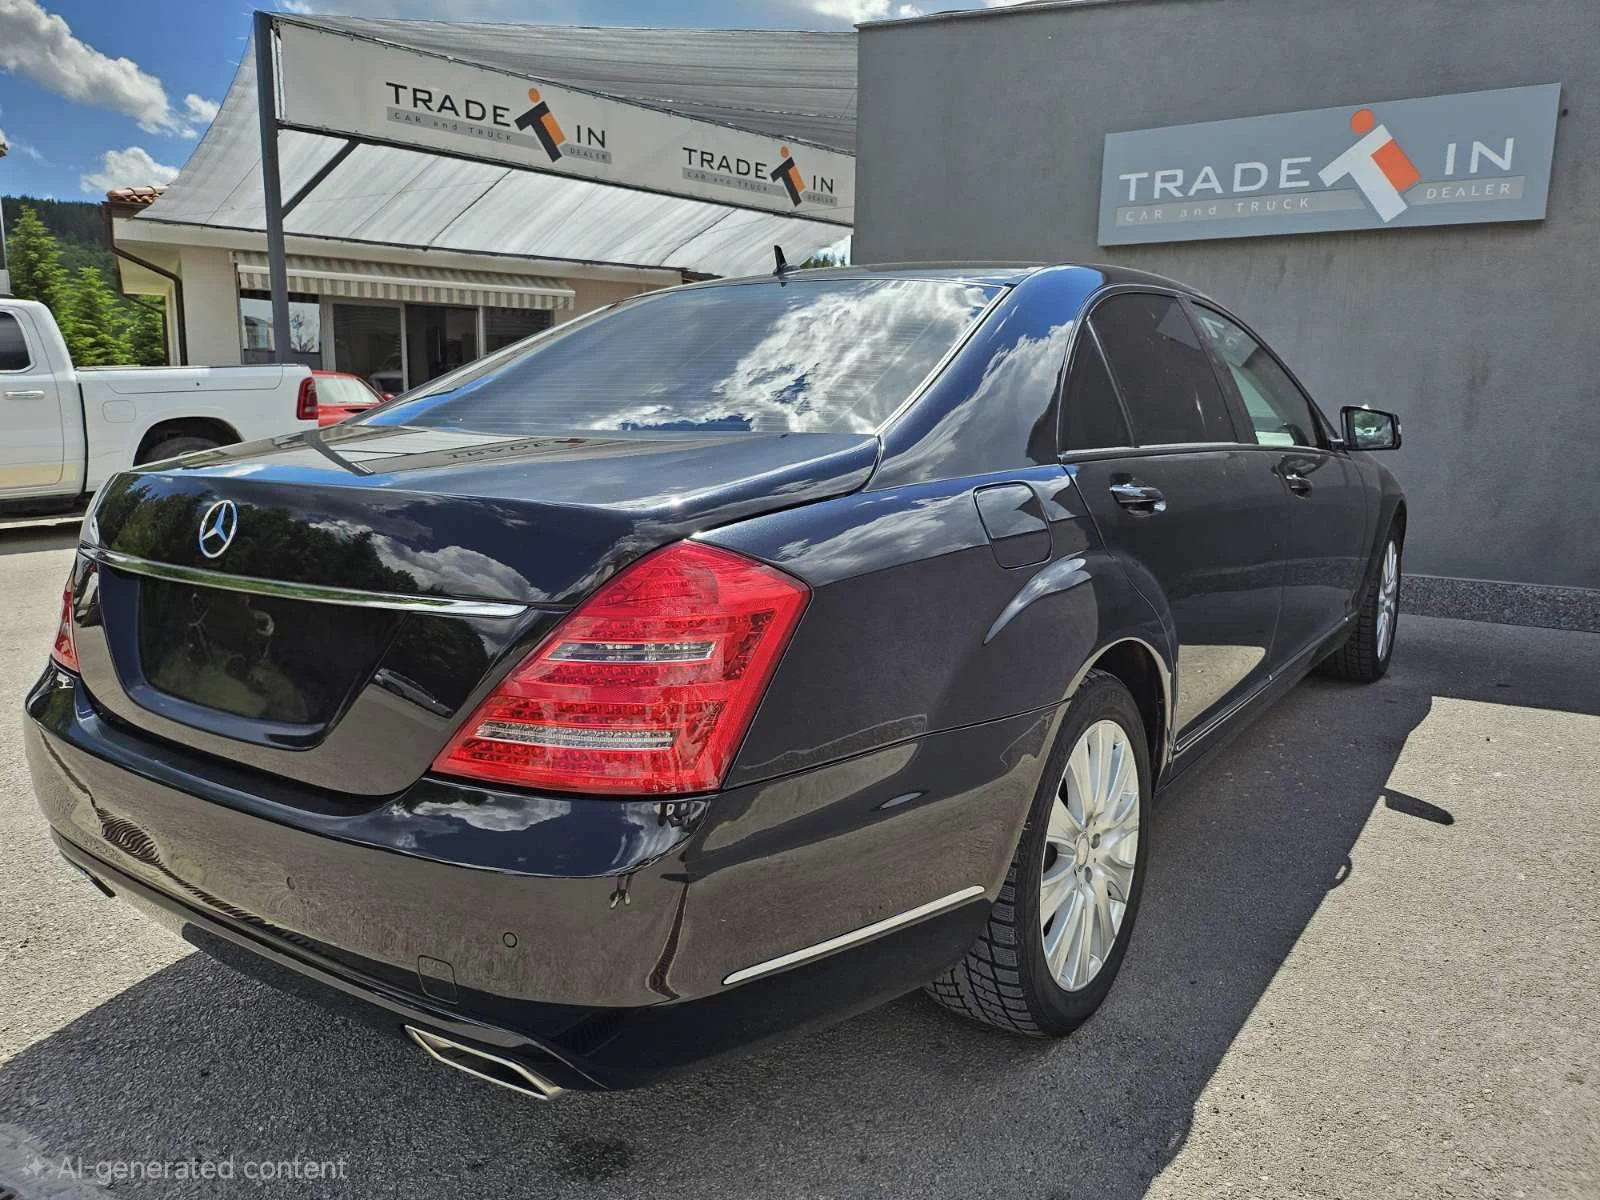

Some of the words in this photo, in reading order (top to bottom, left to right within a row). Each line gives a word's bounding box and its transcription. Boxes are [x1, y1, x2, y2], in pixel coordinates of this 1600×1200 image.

[386, 82, 511, 127] TRADE
[577, 125, 605, 148] IN
[394, 112, 421, 123] CAR
[683, 147, 767, 180] TRADE
[813, 175, 834, 194] IN
[1119, 157, 1312, 201] TRADE
[1444, 137, 1514, 175] IN
[1426, 183, 1511, 199] DEALER
[1125, 209, 1163, 223] CAR
[1180, 205, 1218, 217] and
[1236, 198, 1310, 213] TRUCK
